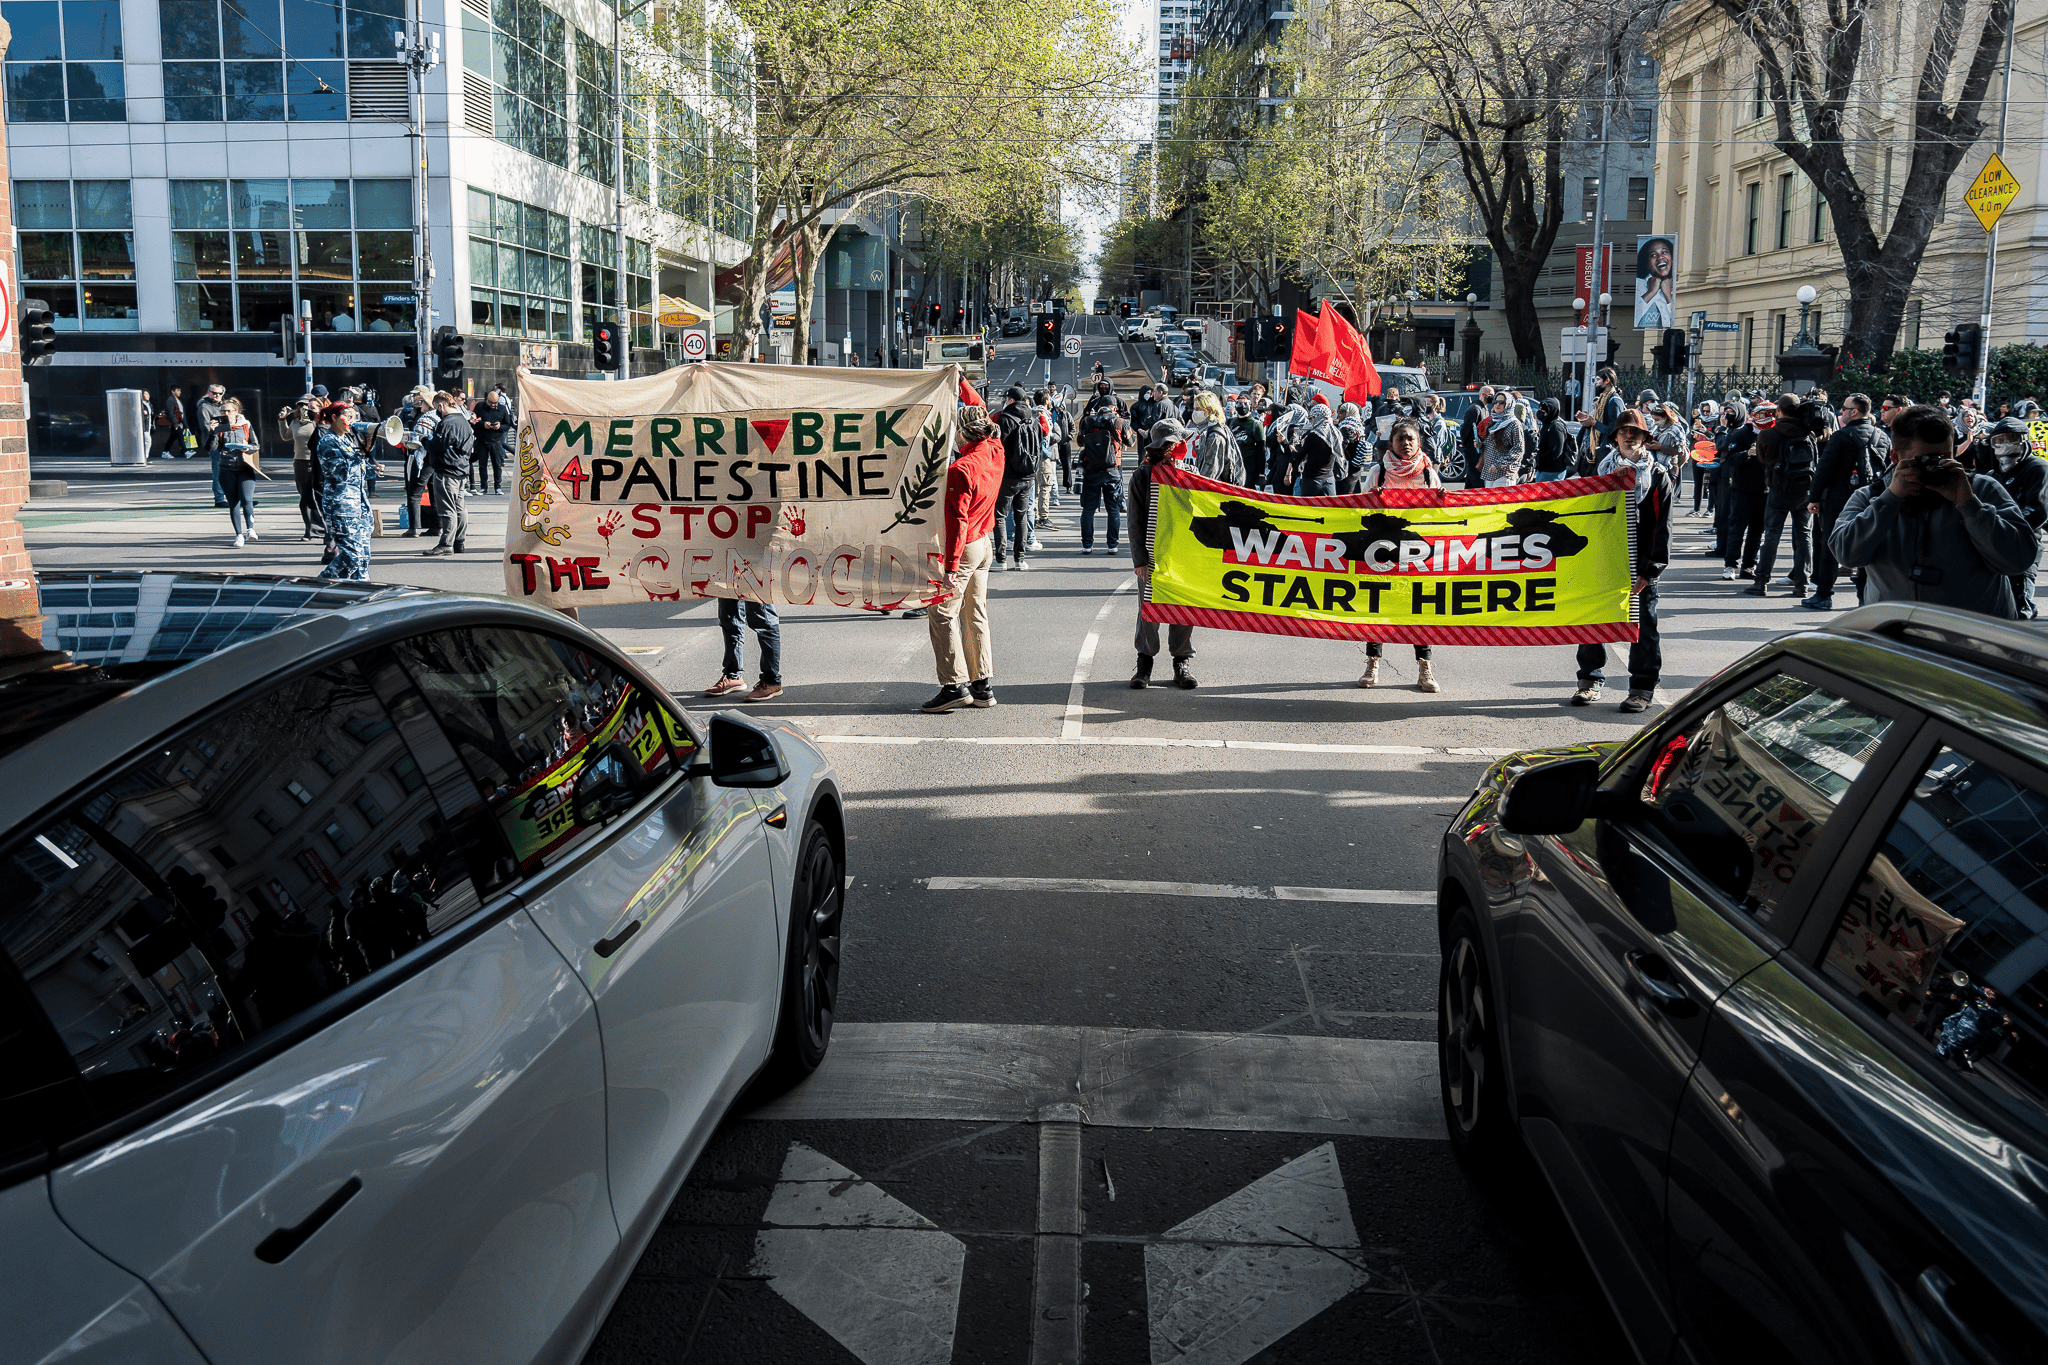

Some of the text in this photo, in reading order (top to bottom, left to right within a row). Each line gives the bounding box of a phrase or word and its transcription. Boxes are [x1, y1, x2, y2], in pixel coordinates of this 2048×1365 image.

[1969, 183, 2014, 200] CLEARANCE
[1983, 170, 2002, 183] LOW
[1979, 201, 2002, 213] 4.0 m
[1584, 251, 1593, 289] MUSEUM
[687, 339, 702, 349] 40
[1066, 342, 1079, 351] 40
[791, 408, 909, 457] BEK
[631, 503, 772, 541] STOP
[1228, 526, 1555, 573] WAR CRIMES
[510, 554, 611, 595] THE
[1221, 570, 1557, 616] START HERE
